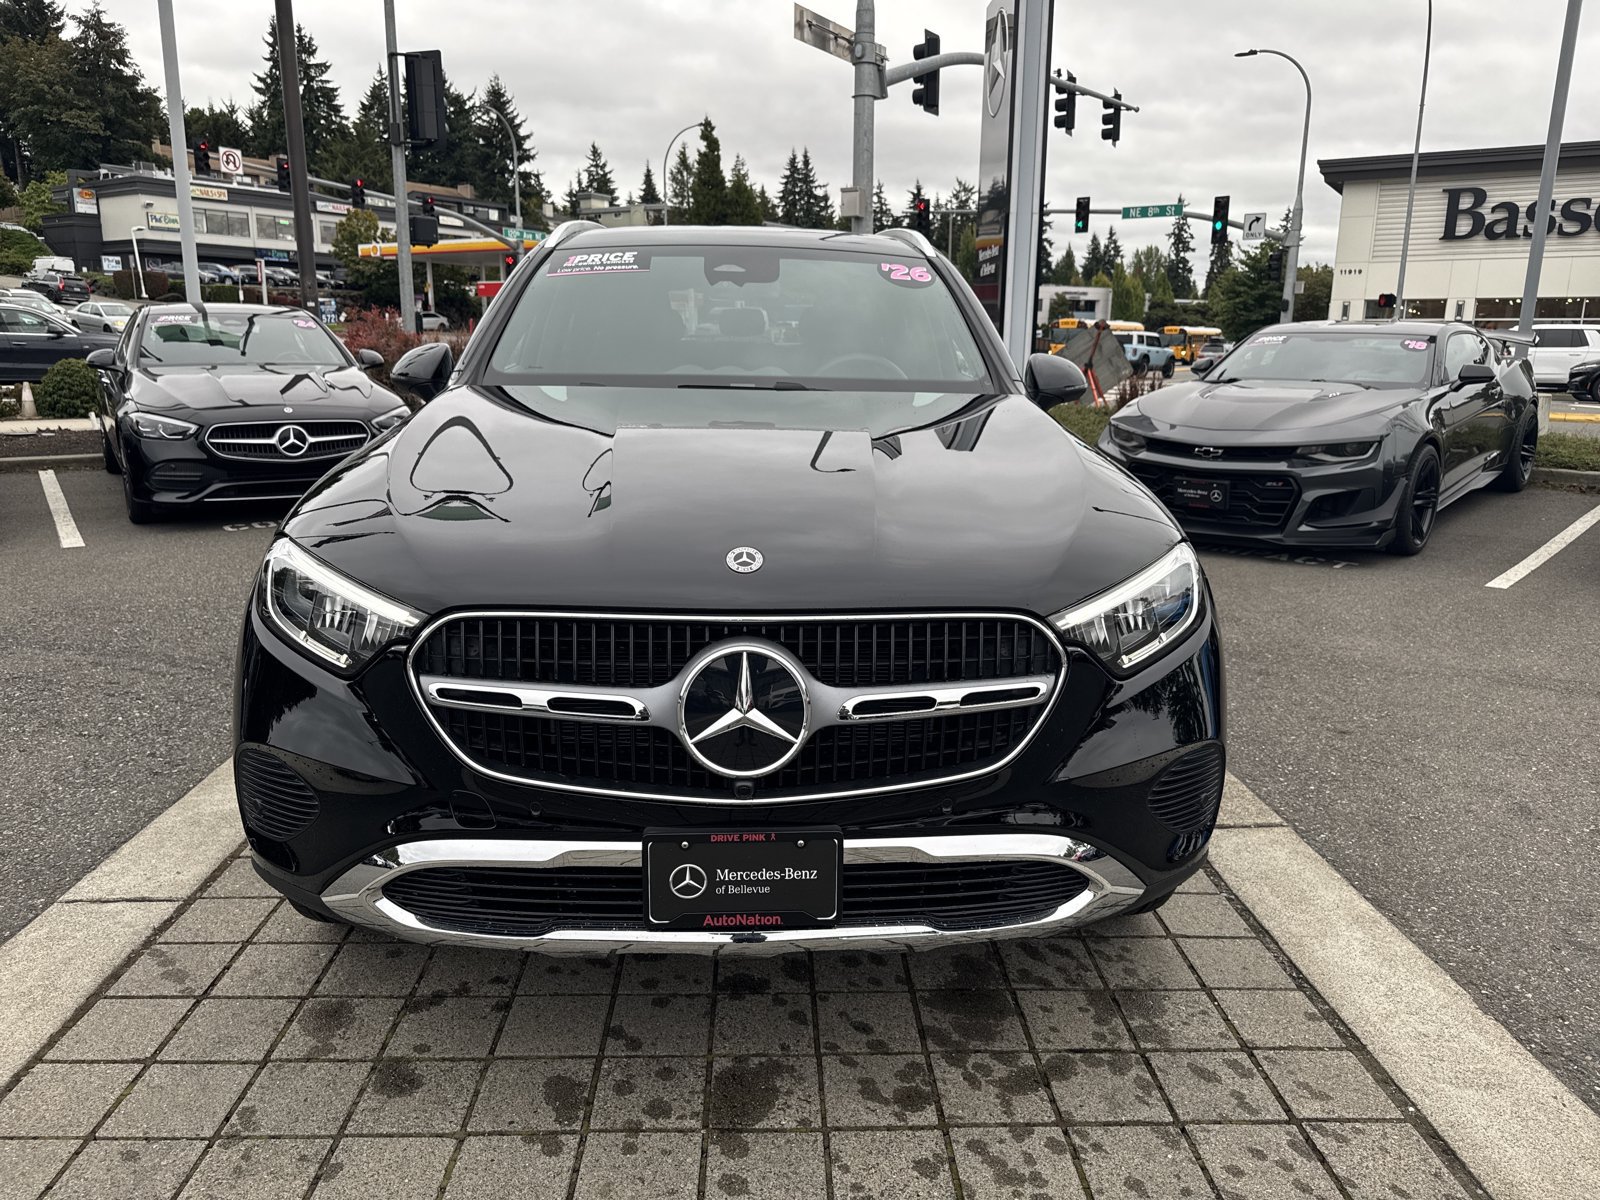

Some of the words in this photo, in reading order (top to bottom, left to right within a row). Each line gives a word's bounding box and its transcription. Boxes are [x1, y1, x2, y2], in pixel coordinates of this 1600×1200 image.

[1129, 207, 1142, 218] NE
[1147, 206, 1160, 217] 8th
[1165, 206, 1176, 216] St
[1438, 186, 1600, 241] Bass
[507, 228, 521, 239] 120th
[523, 231, 533, 241] Ave
[881, 262, 932, 283] '26
[1340, 268, 1363, 276] 11919
[710, 833, 740, 843] DRIVE
[742, 833, 766, 842] PINK
[715, 867, 818, 881] Mercedes-Benz
[715, 885, 726, 895] of
[727, 884, 771, 895] Bellevue
[703, 913, 782, 927] AutoNation
